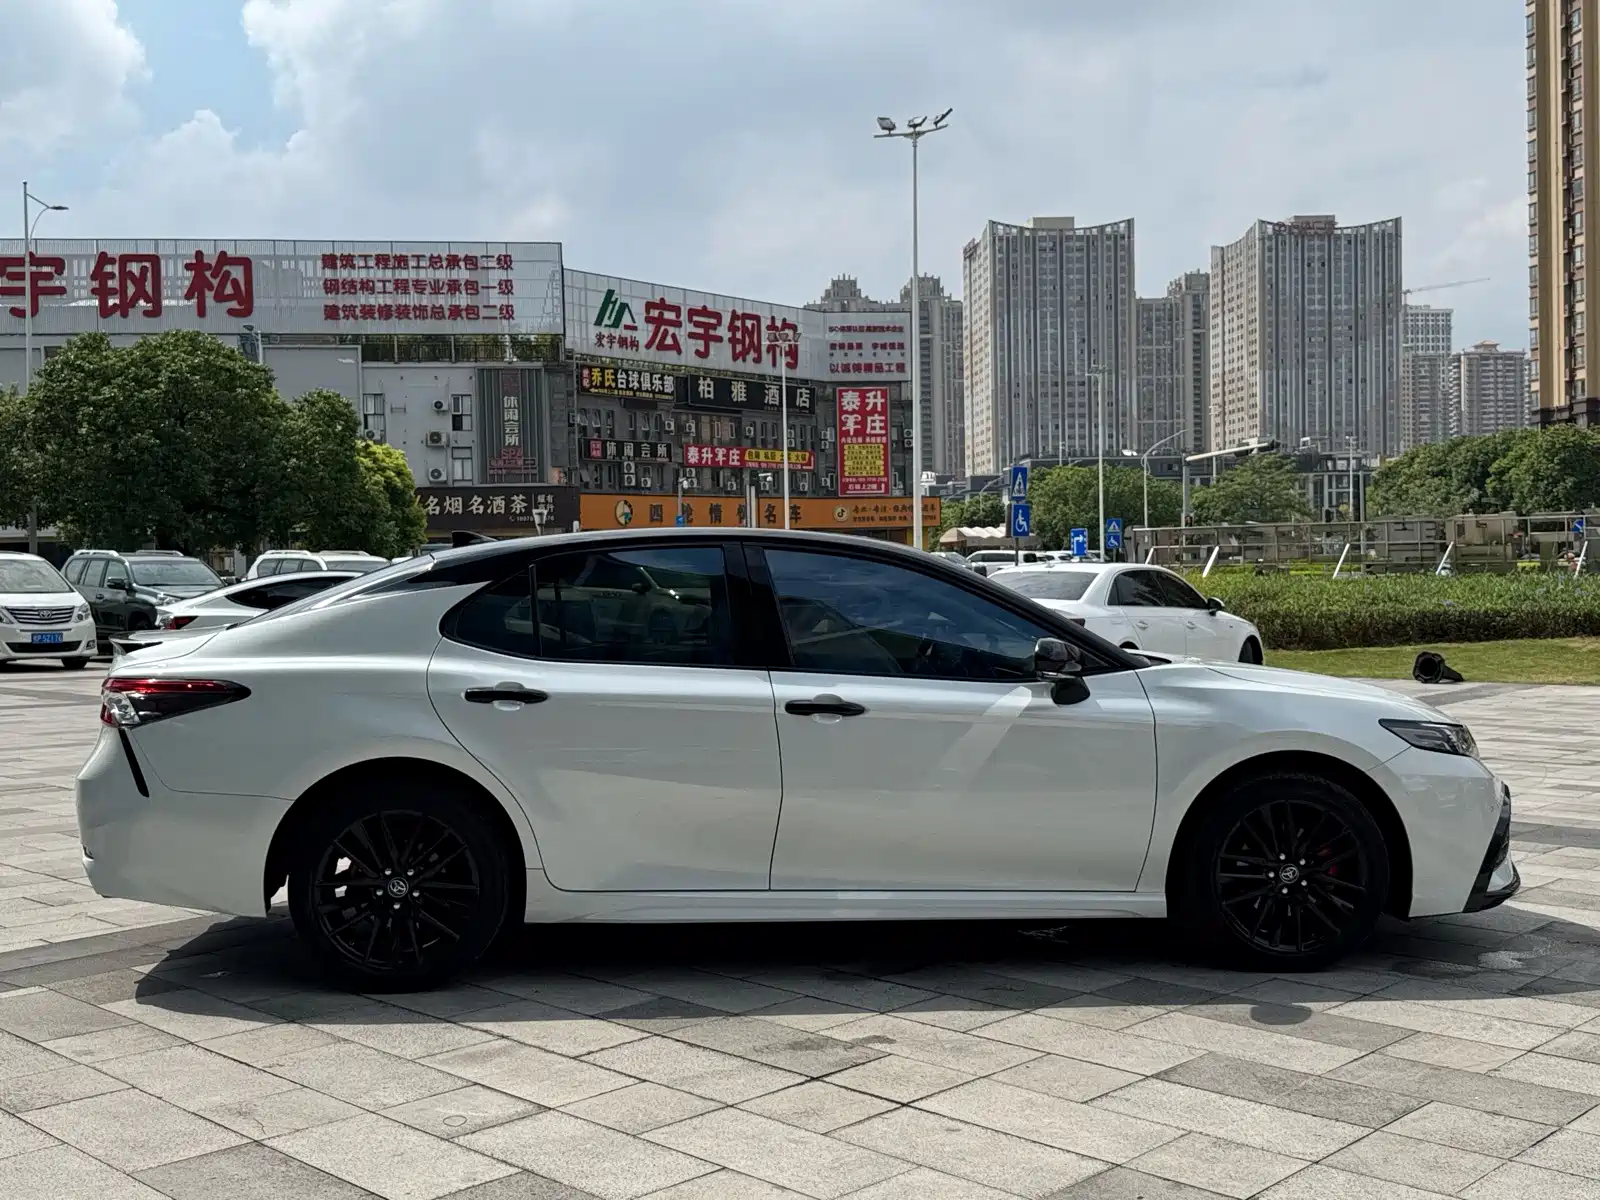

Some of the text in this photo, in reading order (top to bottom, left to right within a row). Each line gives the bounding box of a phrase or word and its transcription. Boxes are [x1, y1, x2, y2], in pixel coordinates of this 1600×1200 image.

[0, 251, 253, 318] 宇钢构
[323, 279, 514, 295] 钢结构工程专业承包一级
[323, 304, 515, 321] 建筑装修装饰总承包二级
[594, 332, 639, 352] 宏宇钢构
[645, 297, 799, 369] 宏宇钢构
[592, 368, 674, 394] 乔氏台球俱乐部
[698, 377, 811, 409] 柏雅酒店
[503, 396, 519, 446] 休闲会所
[607, 441, 667, 458] 休闲会所
[416, 494, 528, 515] 名烟名酒茶
